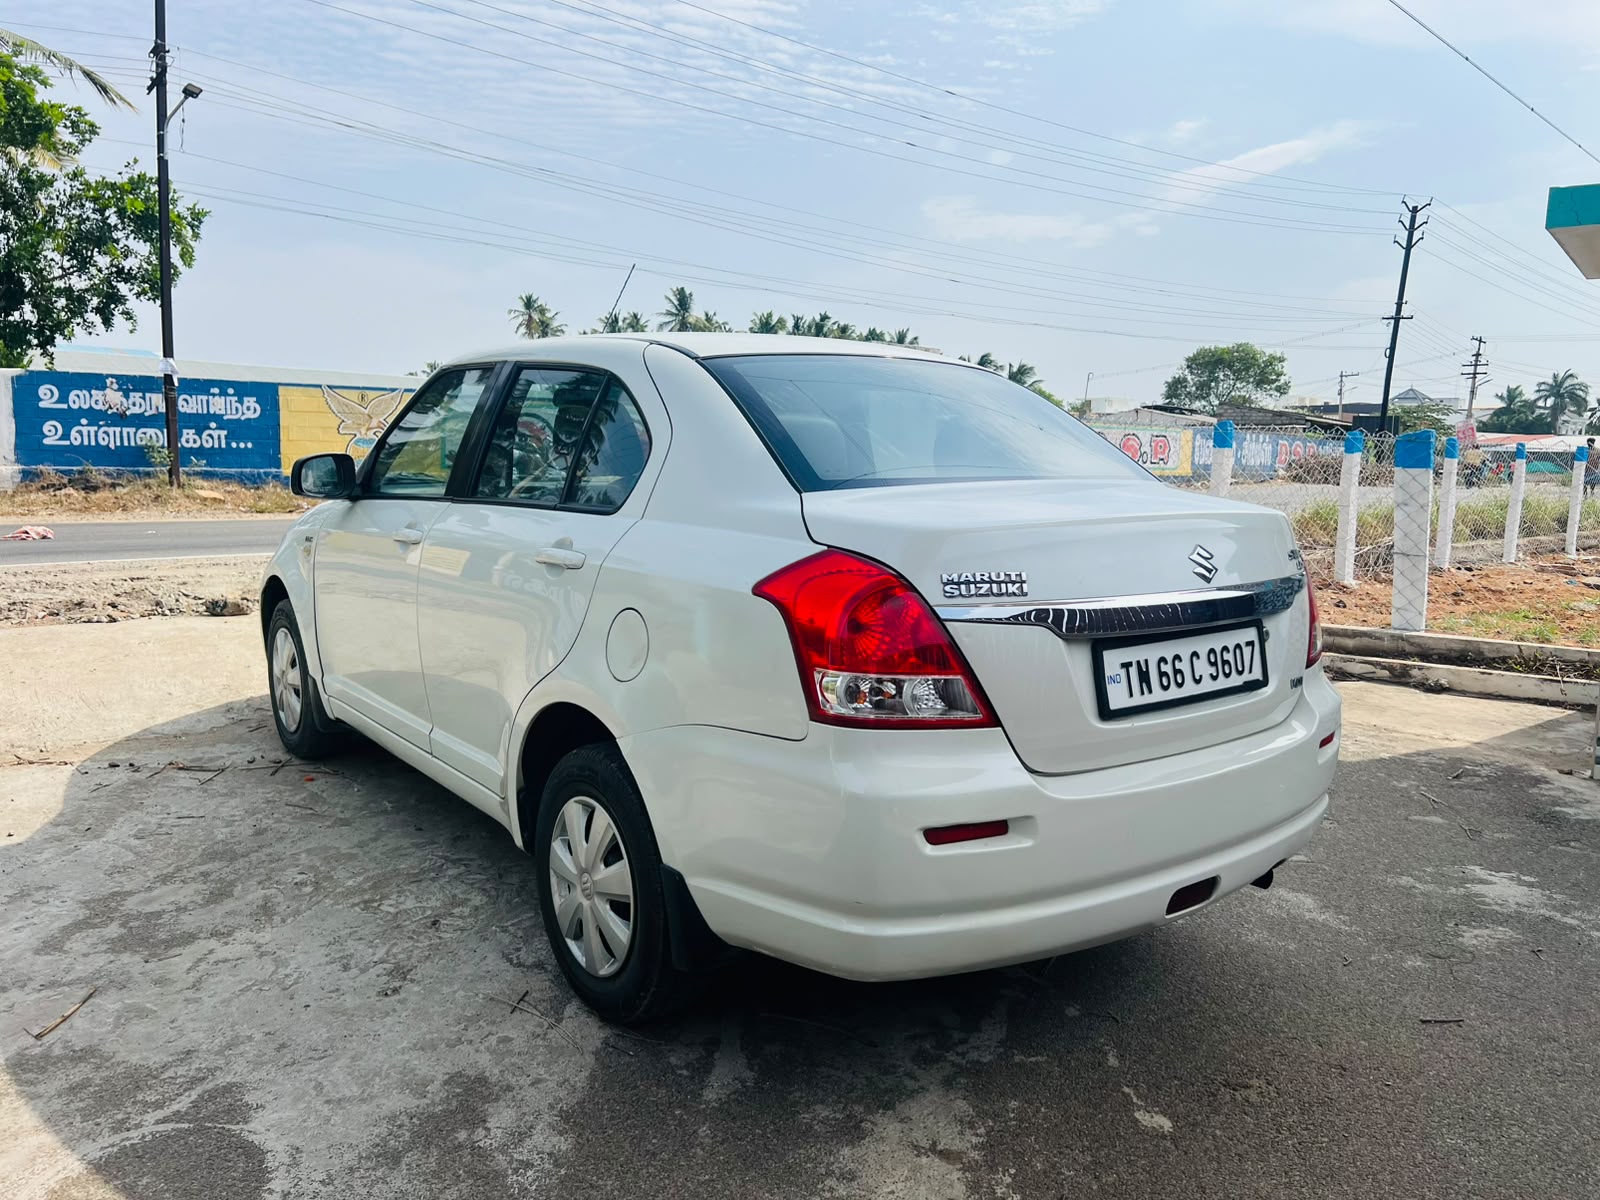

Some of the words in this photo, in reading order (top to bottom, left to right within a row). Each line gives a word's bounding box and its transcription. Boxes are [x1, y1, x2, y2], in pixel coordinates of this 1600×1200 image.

[941, 571, 1027, 583] MARUTI
[943, 582, 1028, 598] SUZUKI
[1120, 658, 1153, 698] TN
[1157, 653, 1185, 692] 66
[1190, 650, 1203, 685] C
[1207, 640, 1255, 681] 9607
[1107, 674, 1121, 685] IND
